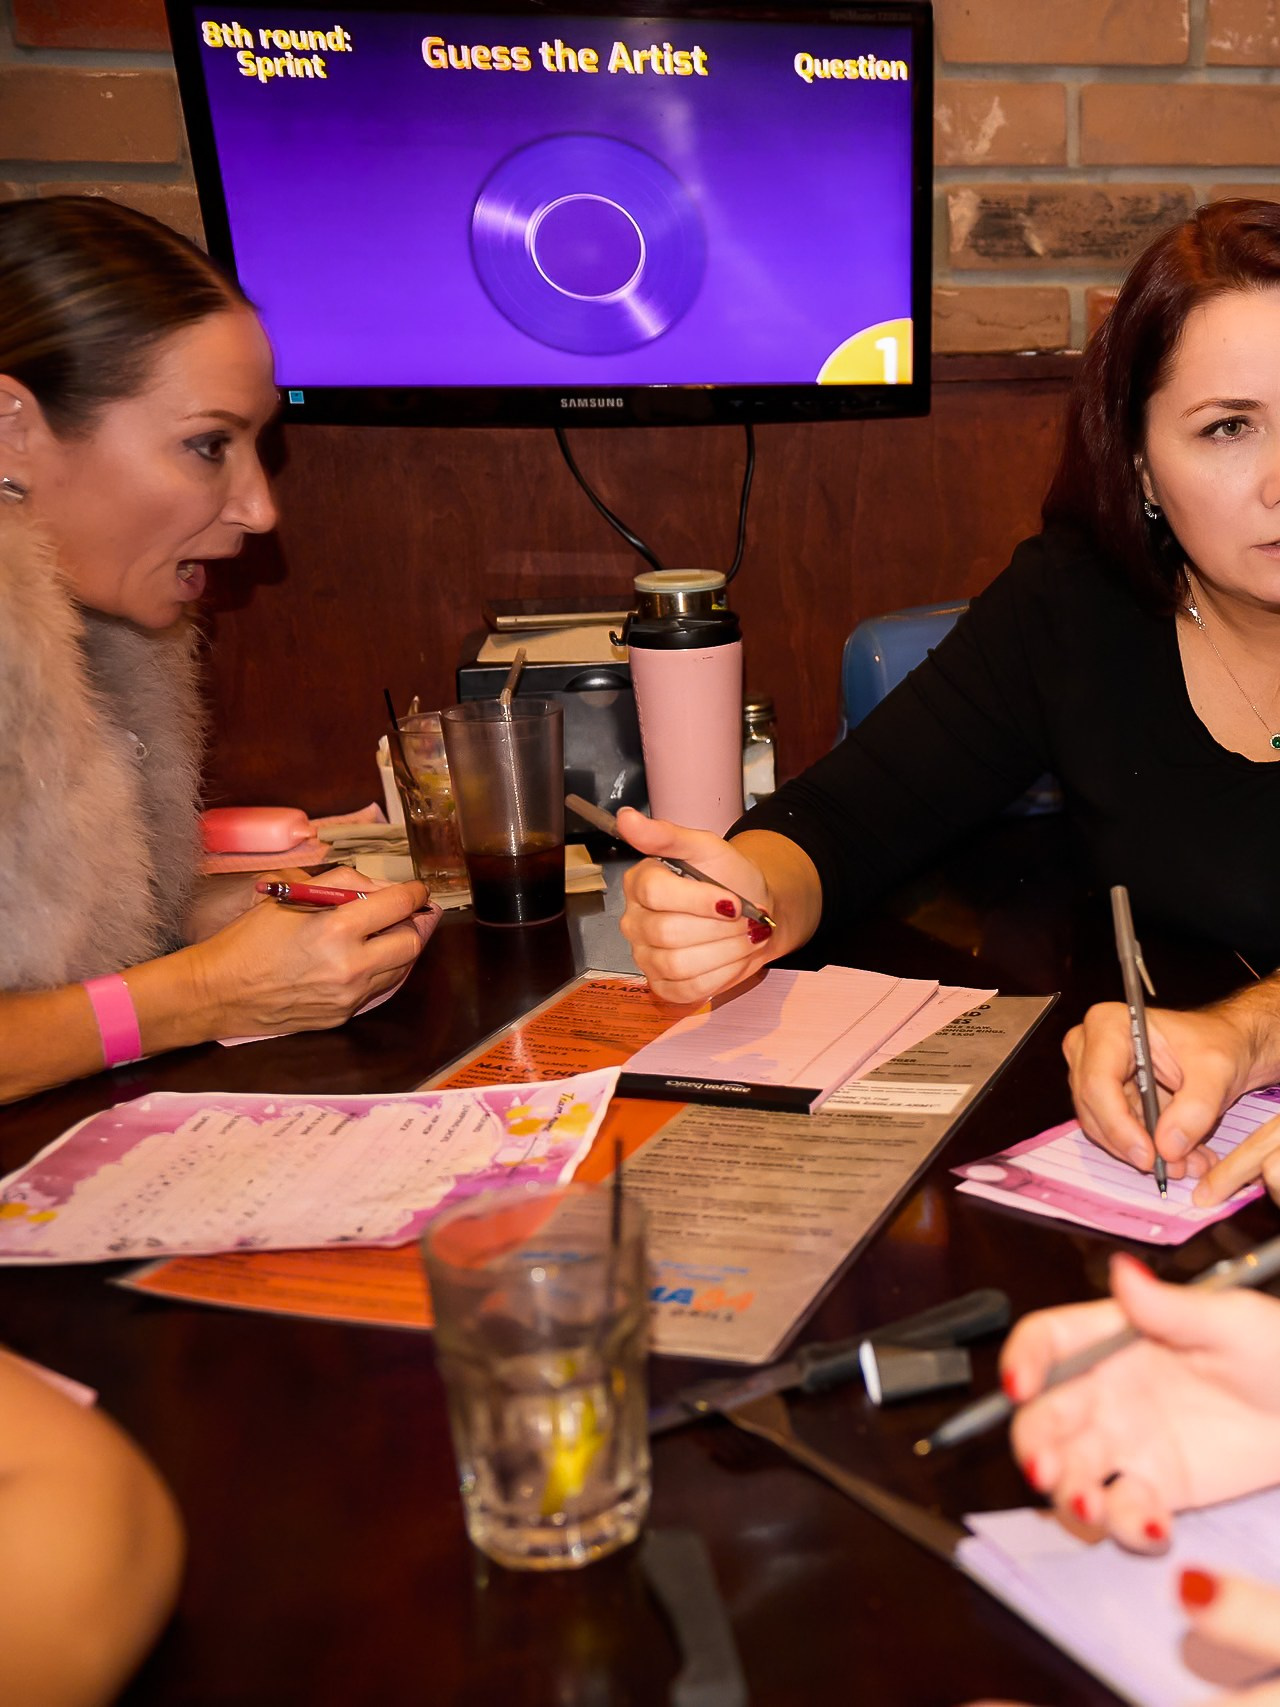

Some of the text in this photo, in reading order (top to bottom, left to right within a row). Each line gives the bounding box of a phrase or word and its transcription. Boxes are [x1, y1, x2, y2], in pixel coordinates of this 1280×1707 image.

[202, 21, 352, 52] 8th round:
[236, 50, 327, 83] Sprint
[421, 36, 708, 76] Guess the Artist
[794, 52, 908, 83] Question
[875, 336, 898, 385] 1
[560, 397, 625, 408] SAMSUNG
[587, 982, 650, 994] SALADS
[476, 1062, 515, 1072] MAC
[664, 1079, 751, 1093] amazon basics
